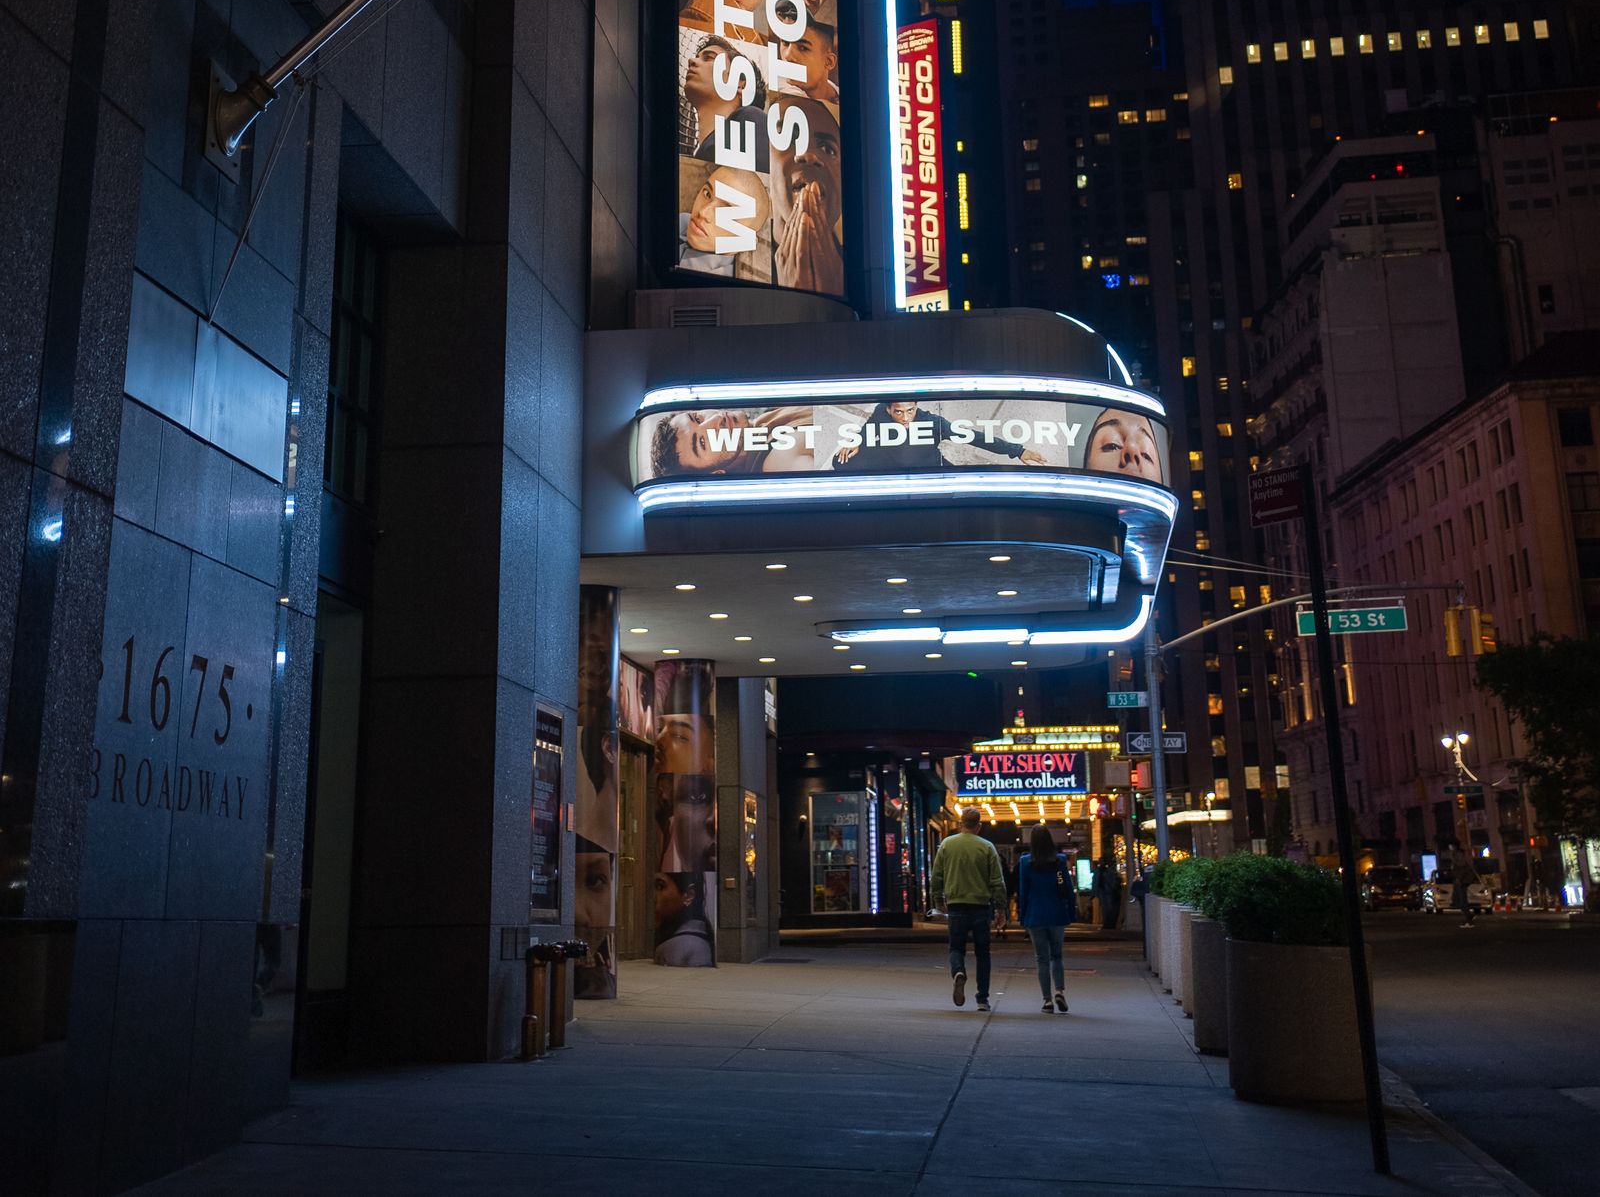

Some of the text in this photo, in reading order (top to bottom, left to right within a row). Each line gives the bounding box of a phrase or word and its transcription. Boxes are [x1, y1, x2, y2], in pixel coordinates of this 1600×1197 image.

[915, 54, 940, 283] NEON SIGN CO.
[706, 419, 1083, 452] WEST SIDE STORY
[1252, 477, 1263, 490] NO
[1253, 487, 1284, 502] Anytime
[1338, 613, 1361, 628] 53
[1367, 612, 1385, 627] St
[117, 634, 235, 745] 1675
[1118, 694, 1128, 706] 53
[964, 753, 1077, 774] LATE SHOW
[965, 772, 1077, 795] stephen colbert
